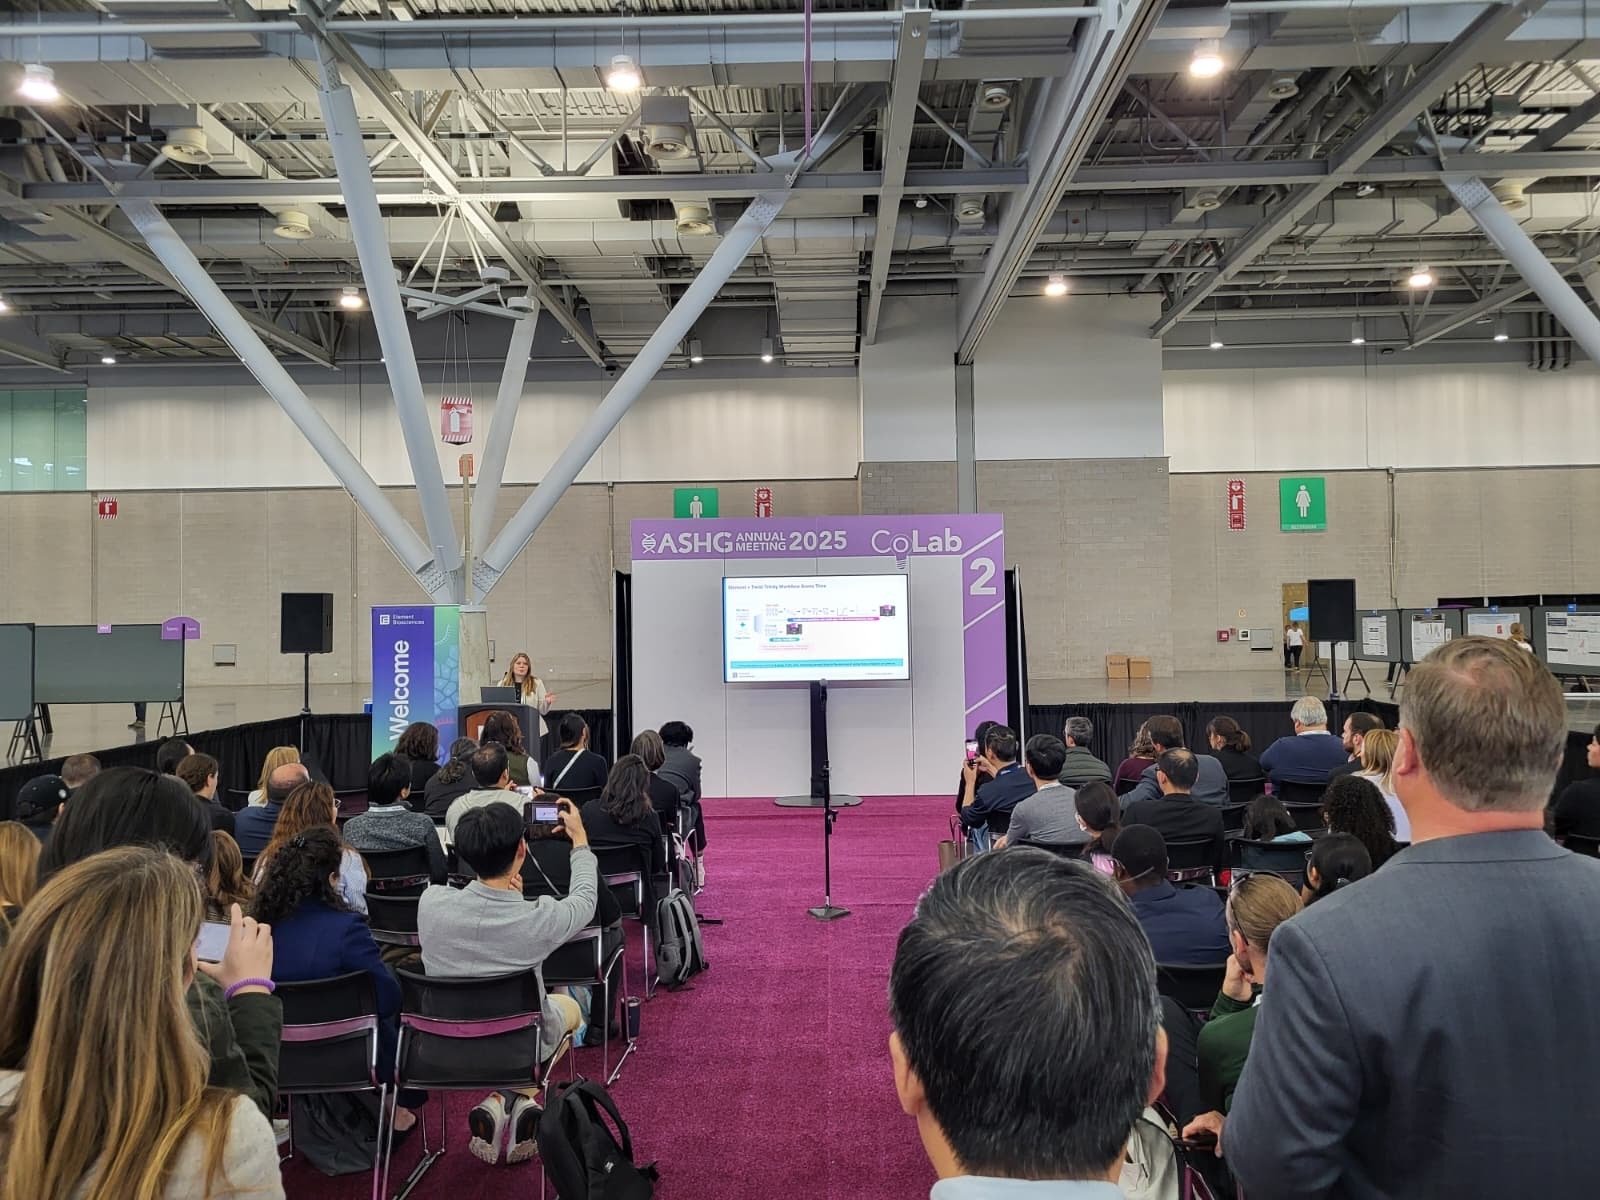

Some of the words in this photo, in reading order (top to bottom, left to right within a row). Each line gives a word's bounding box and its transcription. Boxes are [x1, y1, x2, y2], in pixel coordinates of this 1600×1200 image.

[658, 532, 733, 553] ASHG
[735, 532, 786, 541] ANNUAL
[735, 542, 786, 551] MEETING
[789, 530, 848, 550] 2025
[871, 528, 962, 554] CoLab
[969, 557, 997, 595] 2
[389, 640, 409, 741] Welcome
